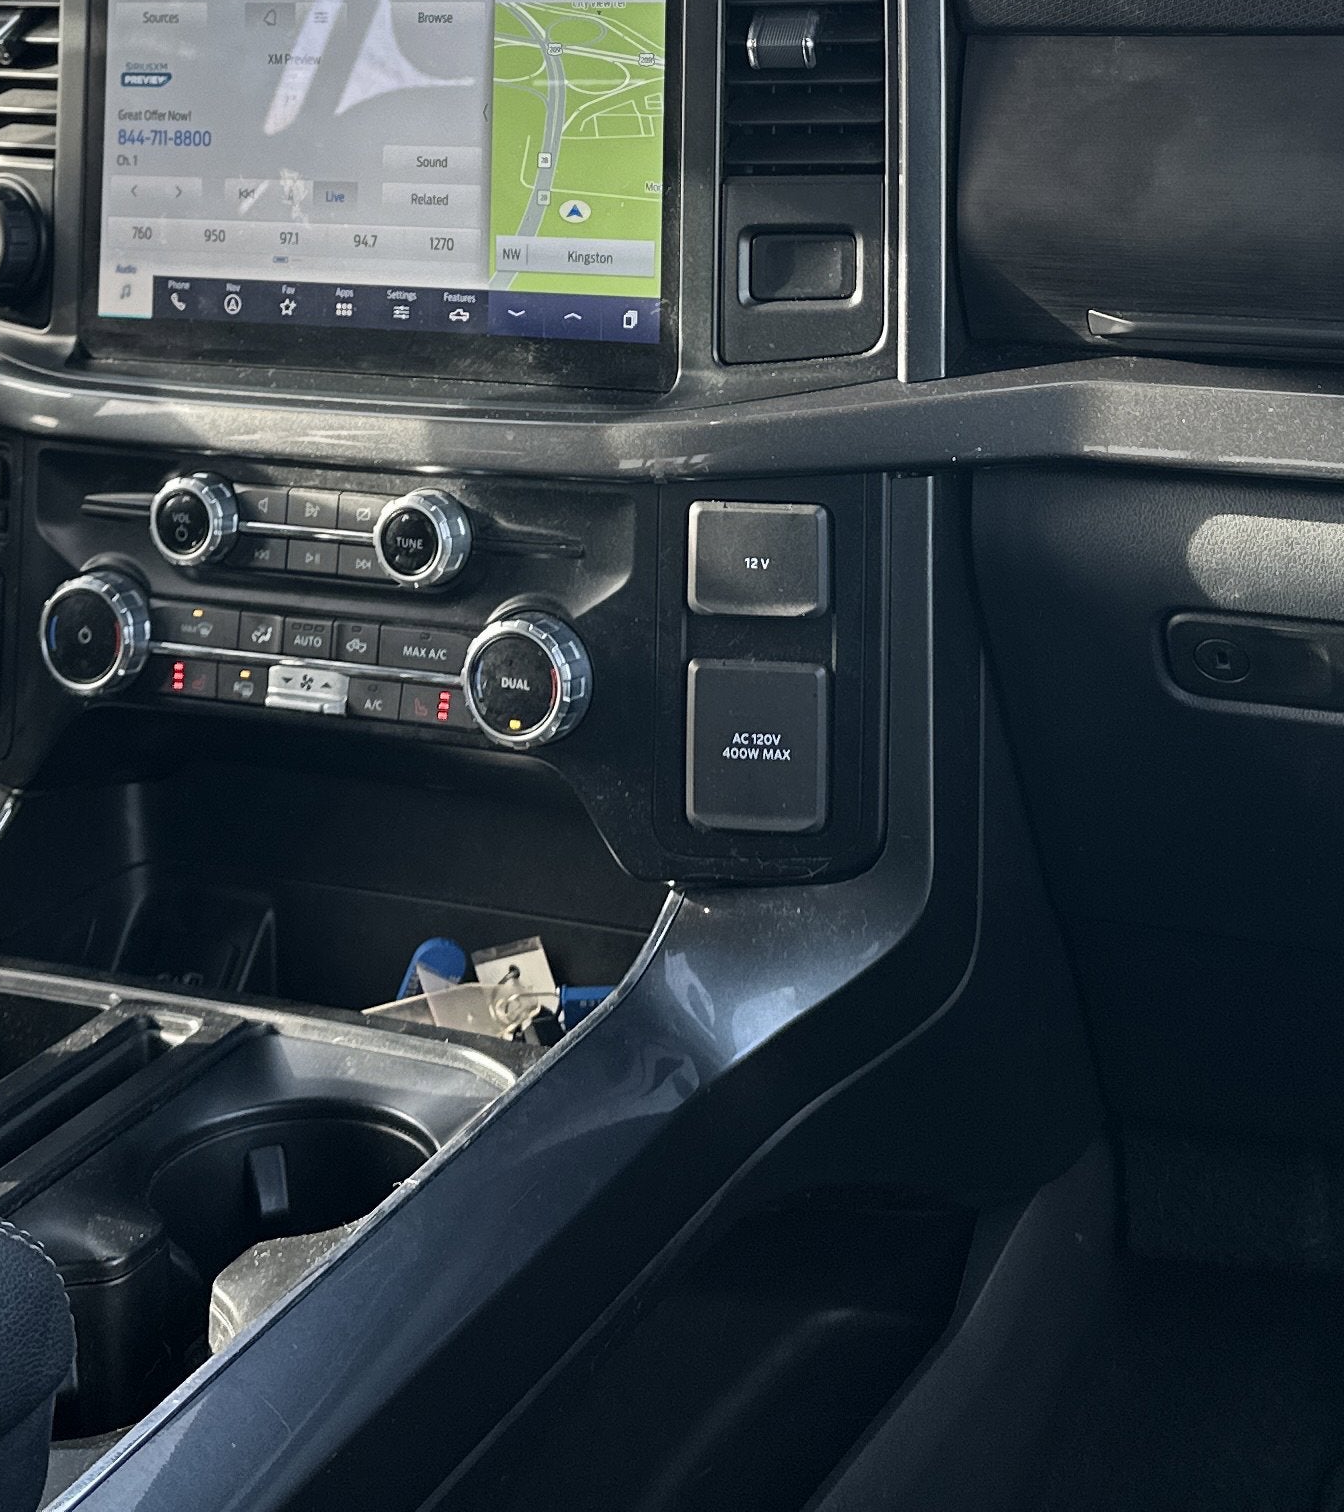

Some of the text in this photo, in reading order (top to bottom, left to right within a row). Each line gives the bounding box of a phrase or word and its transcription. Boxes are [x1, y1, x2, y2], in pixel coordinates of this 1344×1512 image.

[143, 12, 179, 24] Sources
[418, 11, 453, 24] Browse
[267, 54, 321, 66] XM Preview
[118, 109, 192, 122] Great Offer Now!
[118, 129, 211, 147] 844-711-8800
[416, 156, 448, 168] Sound
[325, 191, 345, 203] Live
[411, 193, 448, 206] Related
[132, 226, 152, 240] 760
[204, 229, 226, 242] 950
[353, 235, 378, 248] 94.7
[429, 236, 454, 251] 1270
[502, 248, 613, 265] NW Kingston
[115, 265, 137, 274] Audio
[168, 280, 190, 290] Phone
[226, 283, 241, 292] Nav
[281, 285, 296, 295] Fav
[335, 288, 354, 299] Apps
[386, 290, 417, 302] Settings
[443, 292, 476, 303] Features
[171, 511, 192, 525] VOL
[395, 536, 424, 550] TUNE
[744, 557, 770, 570] 12 V
[294, 635, 323, 648] AUTO
[403, 644, 447, 660] MAX A/C
[501, 676, 530, 691] DUAL
[364, 698, 384, 712] A/C
[732, 733, 782, 746] AC 120V
[722, 746, 791, 761] 400W MAX
